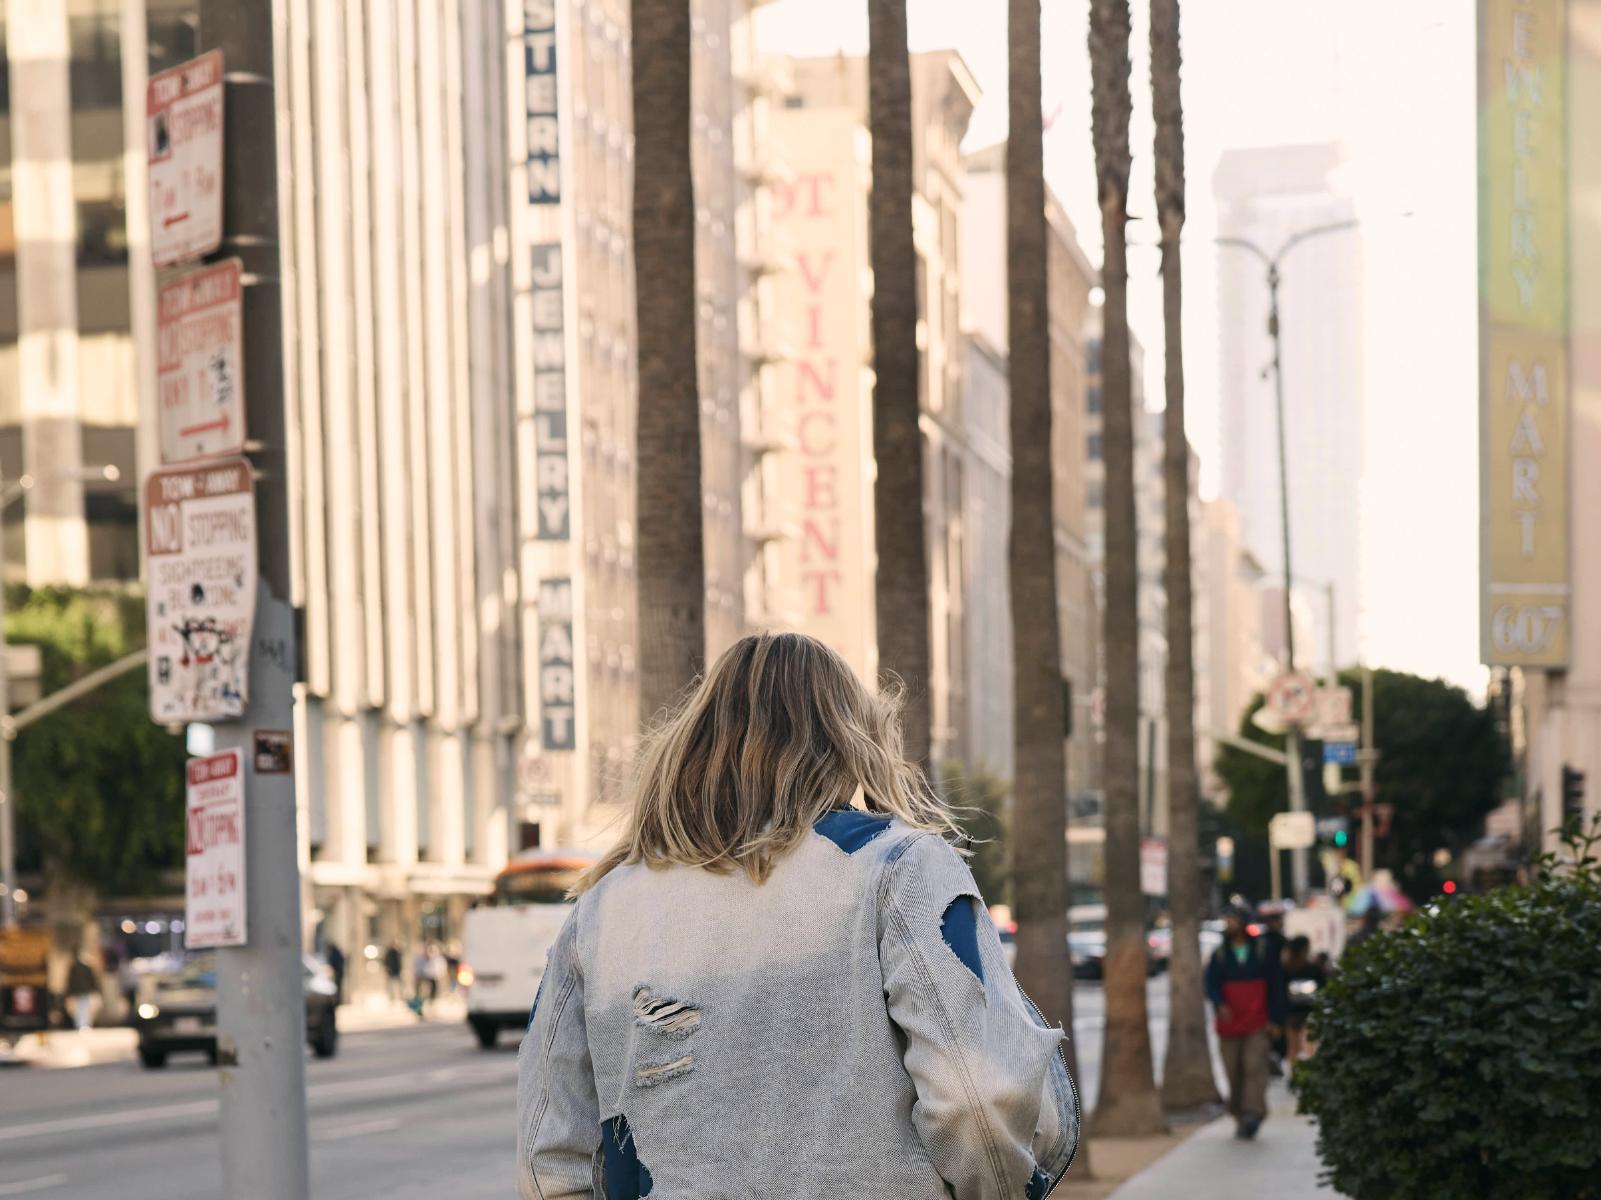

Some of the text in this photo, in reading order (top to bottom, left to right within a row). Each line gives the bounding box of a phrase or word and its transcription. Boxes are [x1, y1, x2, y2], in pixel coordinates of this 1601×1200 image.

[525, 0, 560, 200] STERN
[1502, 0, 1545, 313] EWELRY
[531, 247, 571, 535] JEWELRY
[794, 249, 843, 615] VINCENT
[1503, 358, 1549, 556] MART
[151, 503, 248, 552] NO STOPPING
[541, 583, 576, 746] MART
[1492, 604, 1563, 653] 607
